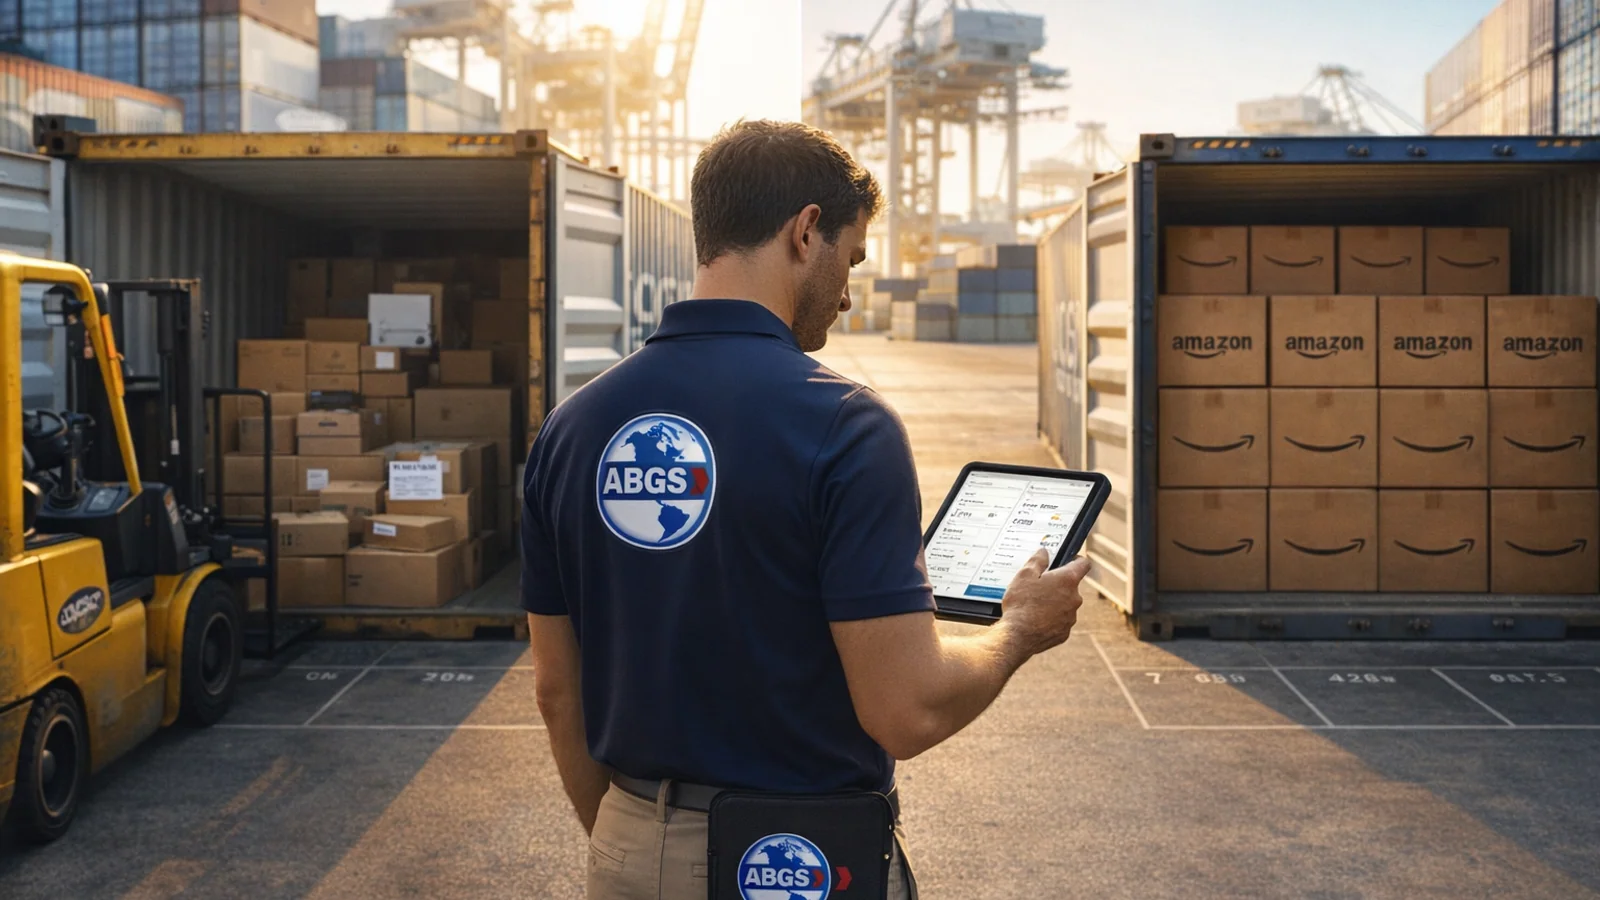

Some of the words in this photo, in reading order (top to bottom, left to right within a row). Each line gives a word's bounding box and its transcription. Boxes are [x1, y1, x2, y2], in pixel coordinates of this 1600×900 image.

[1172, 335, 1253, 351] amazon
[1285, 335, 1364, 351] amazon
[1393, 335, 1473, 351] amazon
[1503, 336, 1584, 352] amazon
[602, 466, 688, 495] ABGS
[744, 867, 810, 888] ABGS
